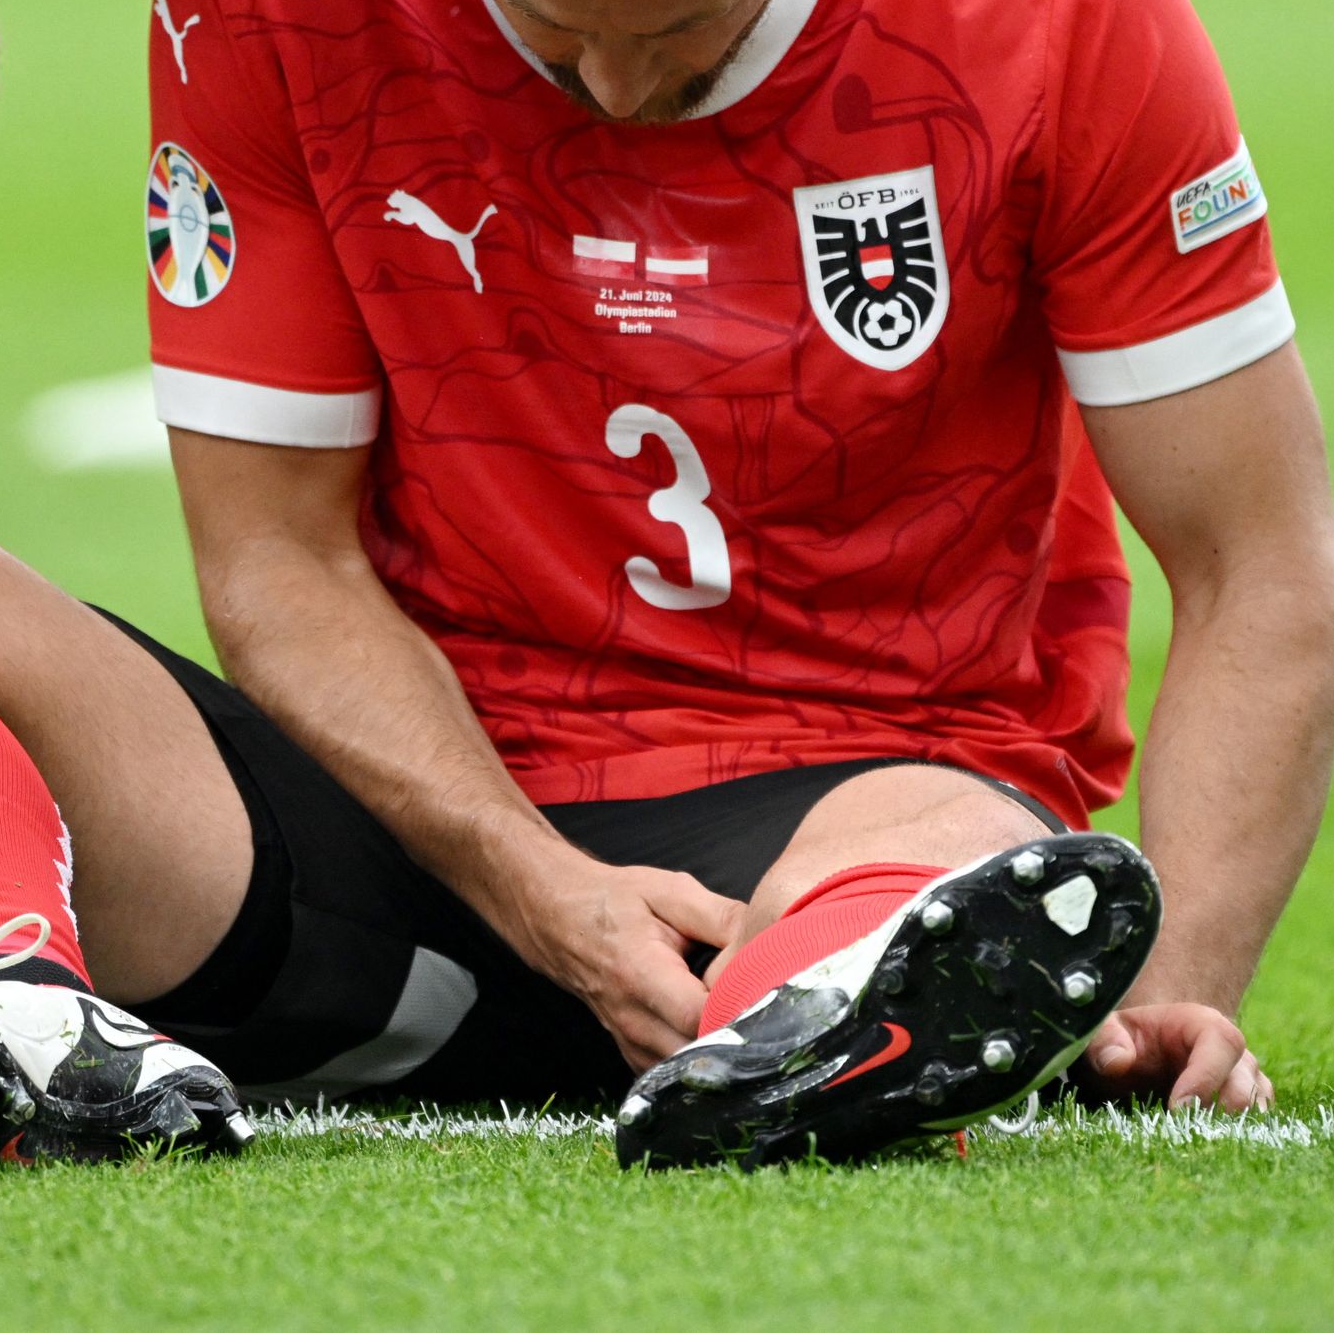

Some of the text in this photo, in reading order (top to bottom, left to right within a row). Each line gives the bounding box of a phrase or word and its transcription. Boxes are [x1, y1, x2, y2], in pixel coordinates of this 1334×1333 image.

[838, 187, 896, 210] ÖFB
[1177, 180, 1212, 209] UEFA
[599, 287, 673, 303] 21. Juni 2024
[594, 304, 677, 320] Olympiastadion
[619, 322, 652, 334] Berlin
[605, 403, 731, 610] 3
